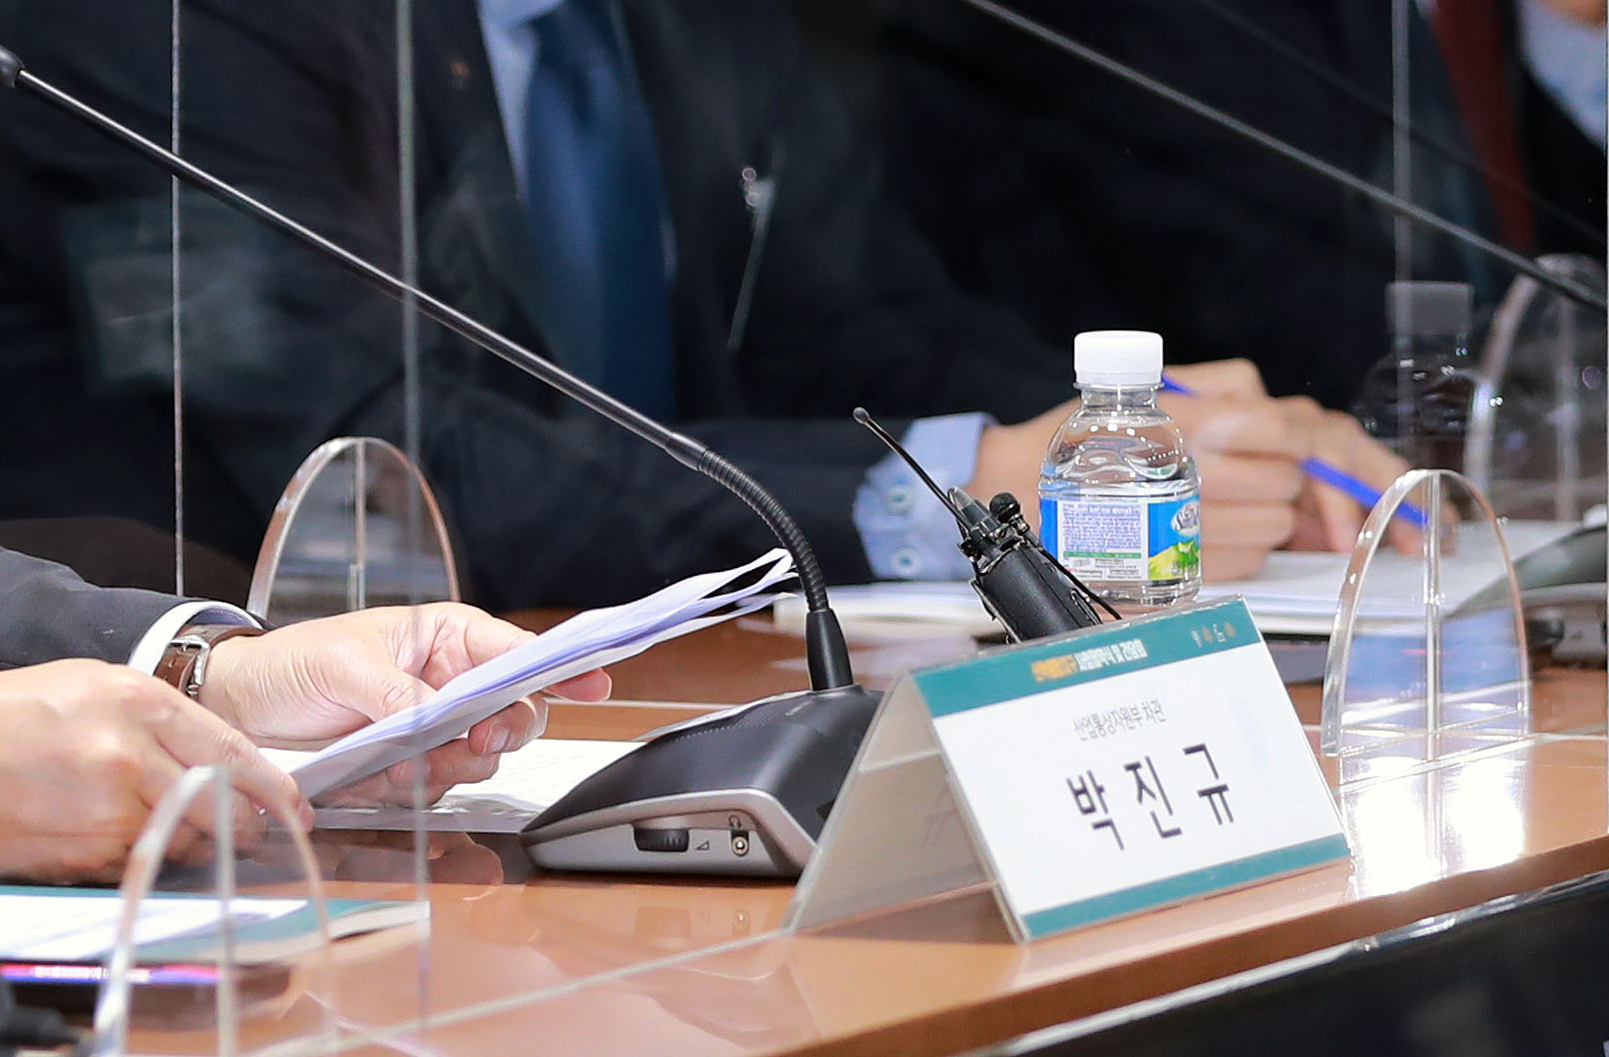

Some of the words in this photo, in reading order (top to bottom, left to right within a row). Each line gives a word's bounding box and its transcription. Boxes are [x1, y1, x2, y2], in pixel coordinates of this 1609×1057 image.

[1073, 703, 1143, 742] 산업통상자원부
[1141, 698, 1167, 724] 차관
[1066, 743, 1234, 851] 박진규
